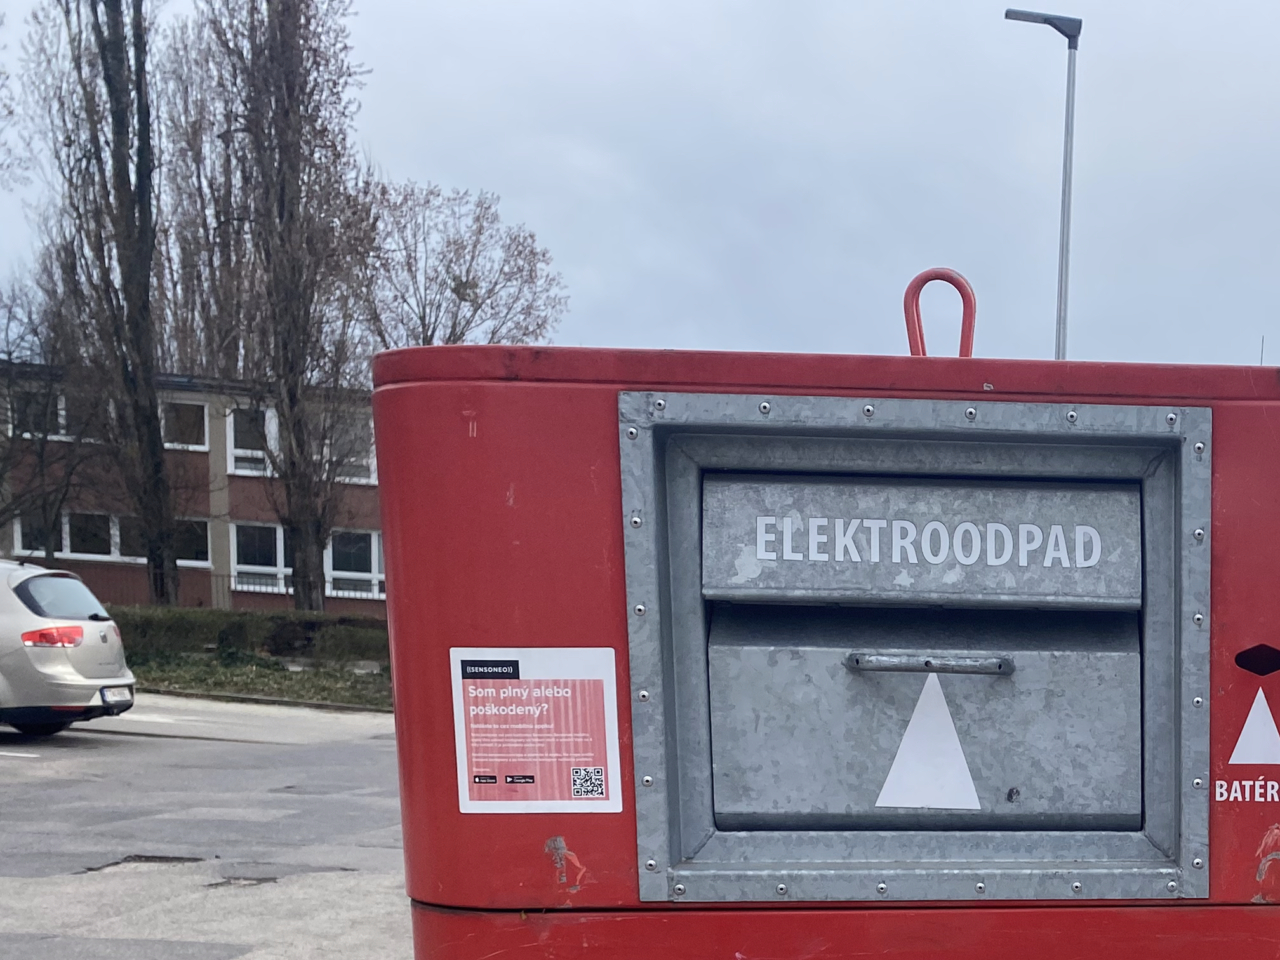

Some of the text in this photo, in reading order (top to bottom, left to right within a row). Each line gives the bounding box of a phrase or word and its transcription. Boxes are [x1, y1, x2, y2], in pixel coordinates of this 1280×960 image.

[755, 515, 1102, 568] ELEKTROODPAD
[468, 685, 572, 700] Som plný alebo
[470, 703, 549, 718] poškodený?
